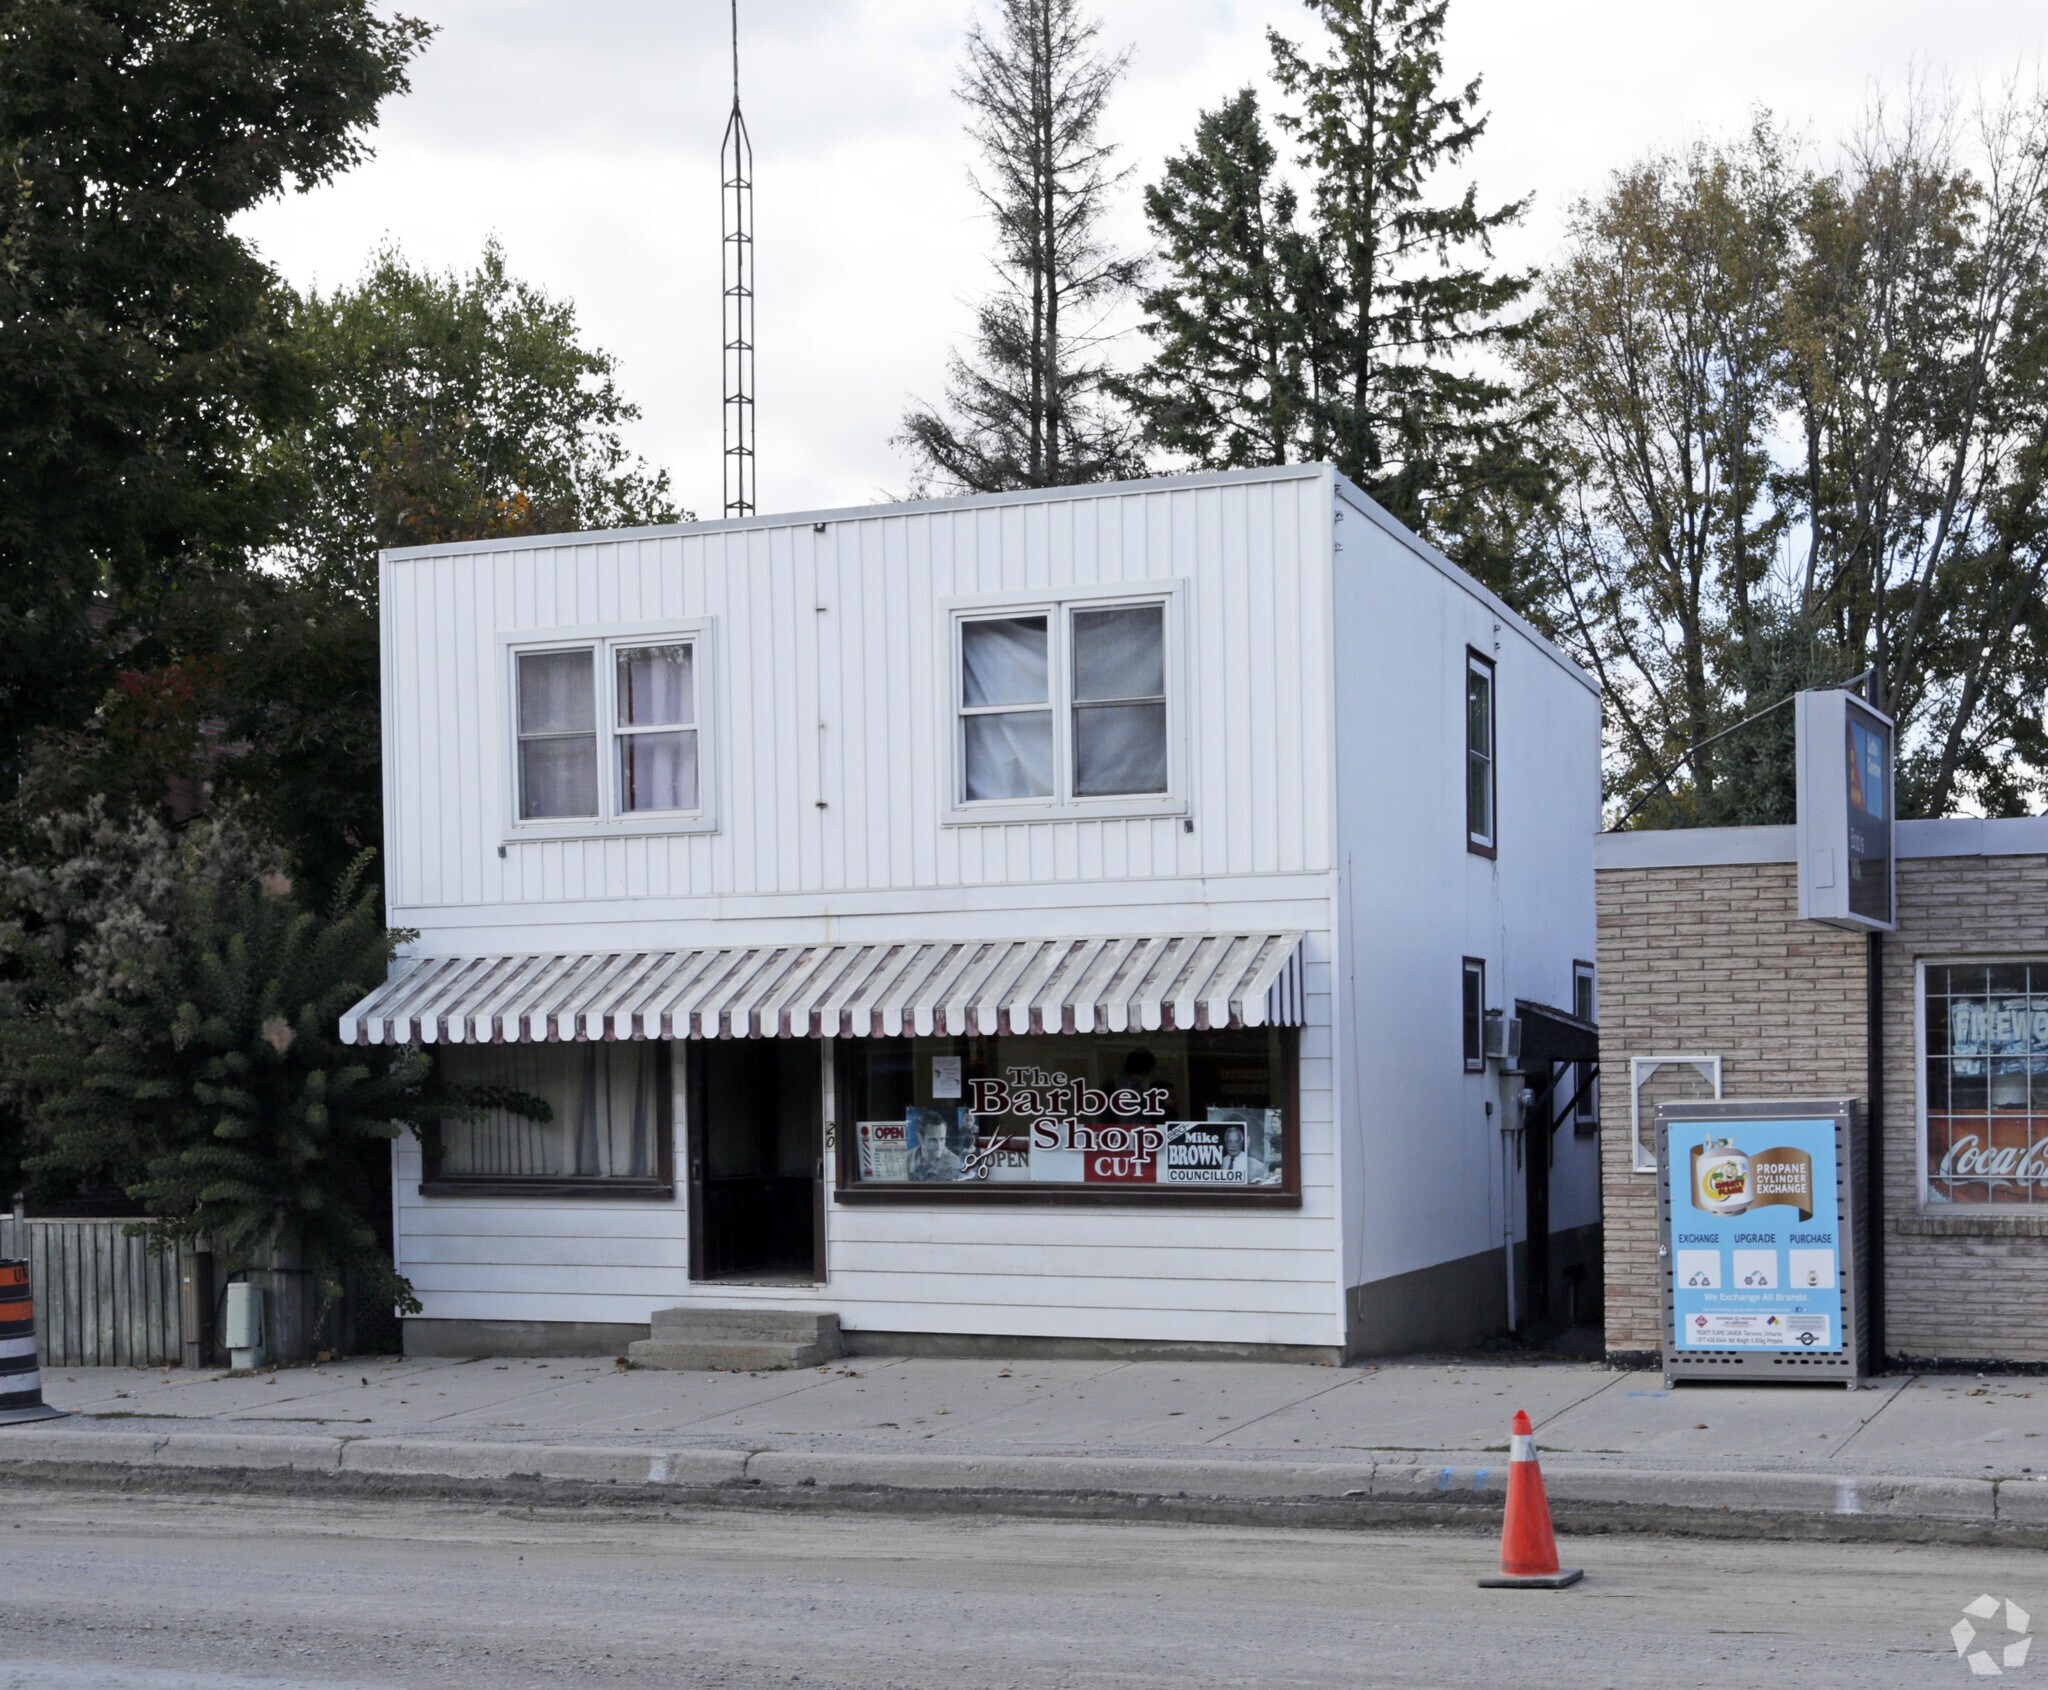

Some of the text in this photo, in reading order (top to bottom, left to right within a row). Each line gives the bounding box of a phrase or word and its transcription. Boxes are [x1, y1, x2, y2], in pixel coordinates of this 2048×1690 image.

[1007, 1066, 1068, 1087] The
[968, 1077, 1169, 1117] Barber
[875, 1127, 905, 1139] OPEN
[1167, 1124, 1189, 1140] elect
[1184, 1132, 1219, 1143] Mike
[1033, 1117, 1166, 1163] Shop
[981, 1151, 1029, 1168] OPEN
[1168, 1144, 1223, 1166] BROWN
[1094, 1157, 1144, 1177] CUT
[1756, 1163, 1806, 1174] PROPANE
[1170, 1170, 1243, 1181] COUNCILLOR
[1756, 1175, 1807, 1183] CYLINDER
[1756, 1183, 1807, 1194] EXCHANGE
[1678, 1233, 1720, 1244] EXCHANGE
[1734, 1233, 1776, 1243] UPGRADE
[1789, 1233, 1833, 1244] PURCHASE
[1704, 1293, 1718, 1301] We
[1720, 1293, 1760, 1303] Exchange
[1762, 1293, 1774, 1301] All
